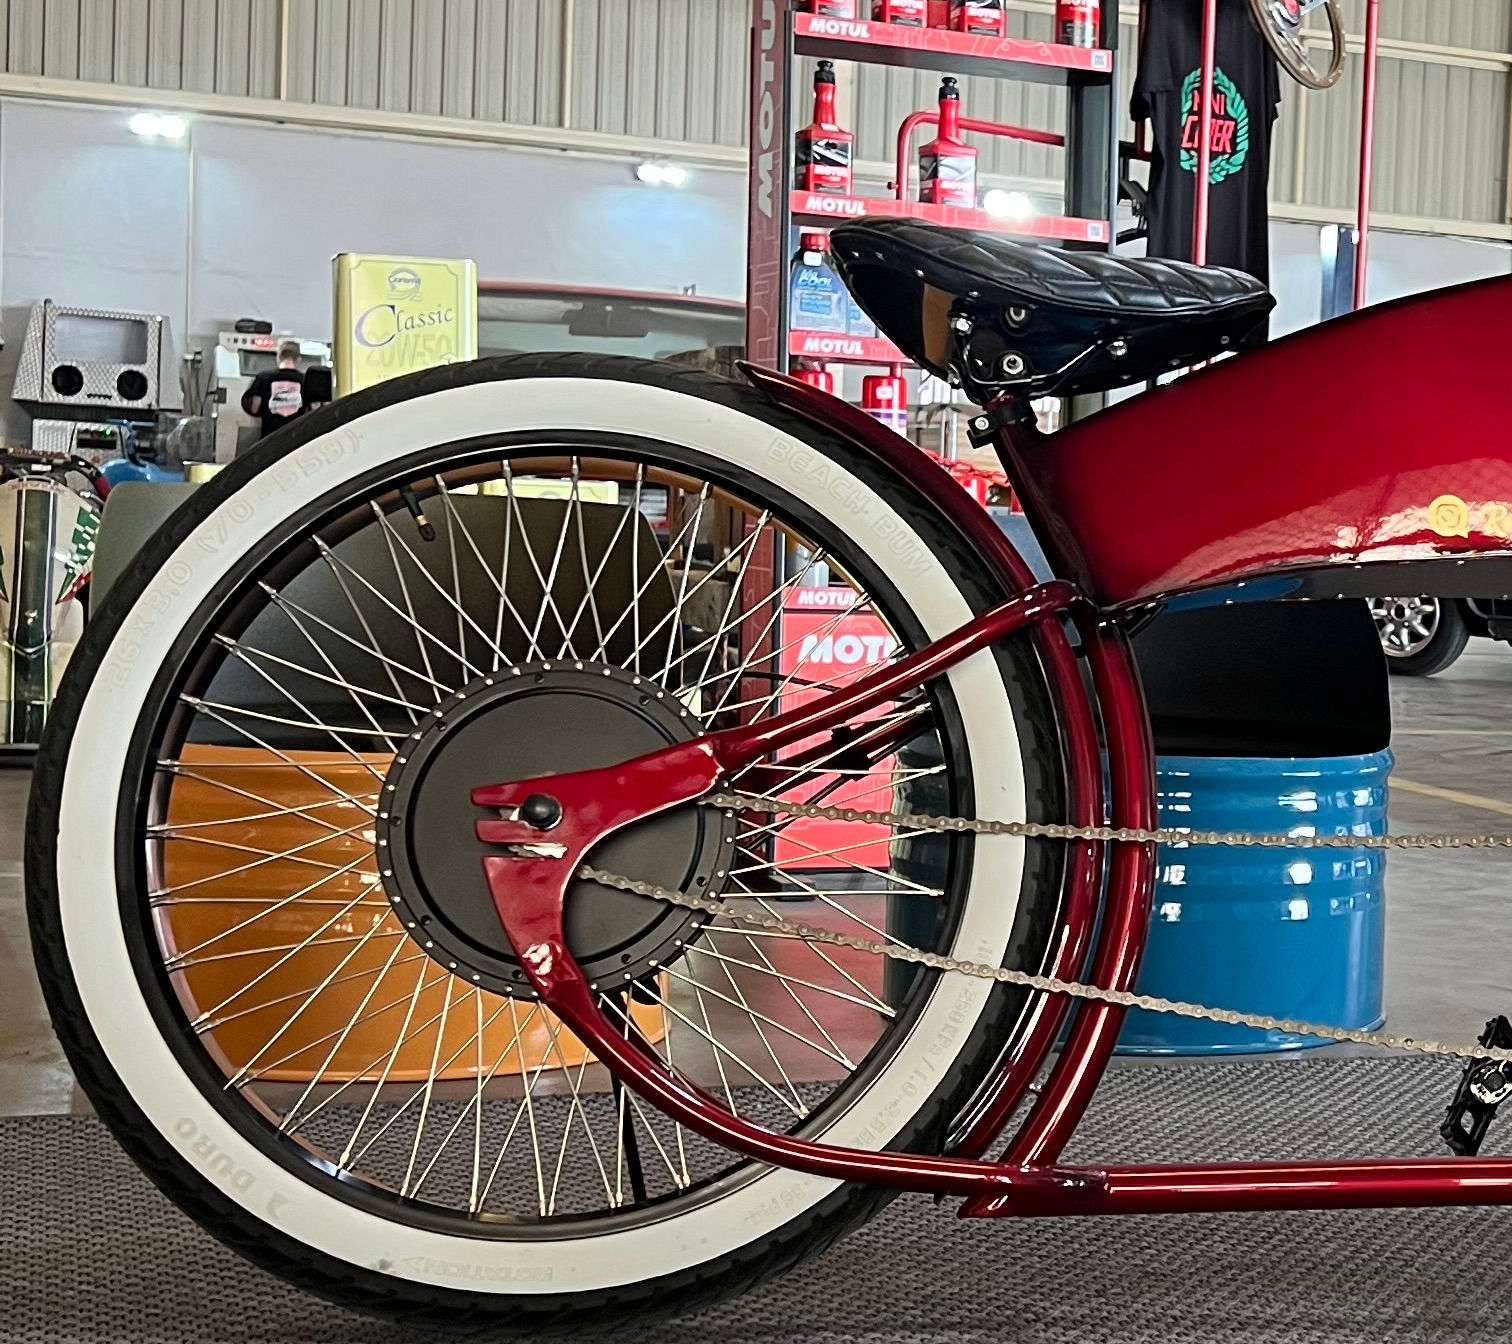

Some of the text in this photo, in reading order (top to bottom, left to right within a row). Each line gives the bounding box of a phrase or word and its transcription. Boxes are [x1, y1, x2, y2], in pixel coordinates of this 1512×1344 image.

[808, 17, 870, 39] MOTUL
[806, 196, 866, 216] MOTUL
[354, 303, 454, 348] Classic
[803, 337, 864, 355] MOTUL
[767, 436, 931, 575] BEACH BUM
[173, 1116, 256, 1197] DURO
